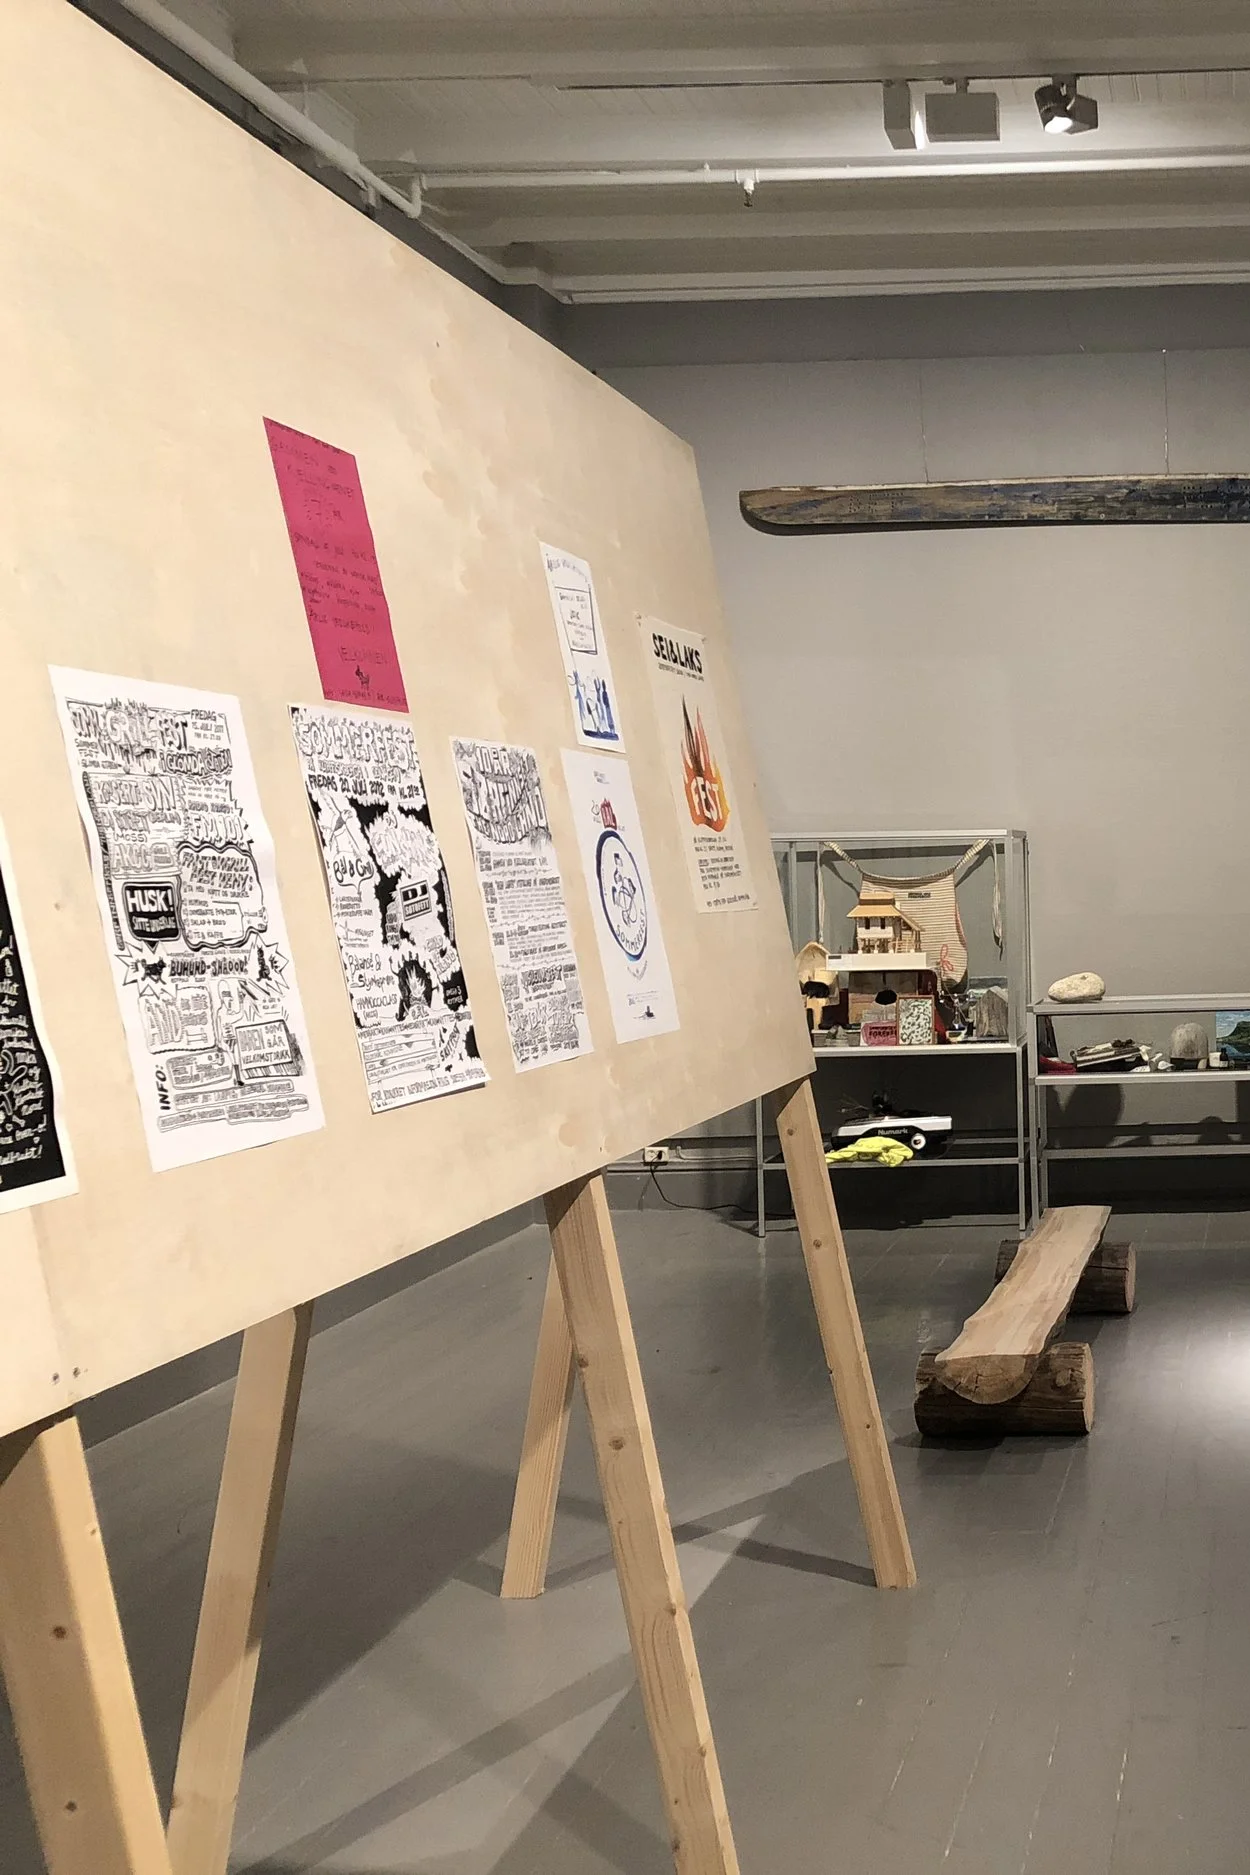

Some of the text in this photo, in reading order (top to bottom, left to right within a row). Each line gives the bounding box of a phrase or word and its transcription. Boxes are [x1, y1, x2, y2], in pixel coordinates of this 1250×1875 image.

[190, 709, 217, 722] FREDAG
[300, 721, 417, 771] SOMMERFEST
[690, 776, 722, 822] FEST
[125, 888, 174, 913] HUSK!
[401, 884, 429, 902] DJ
[155, 1064, 171, 1111] INFO:
[877, 1128, 909, 1136] Numark
